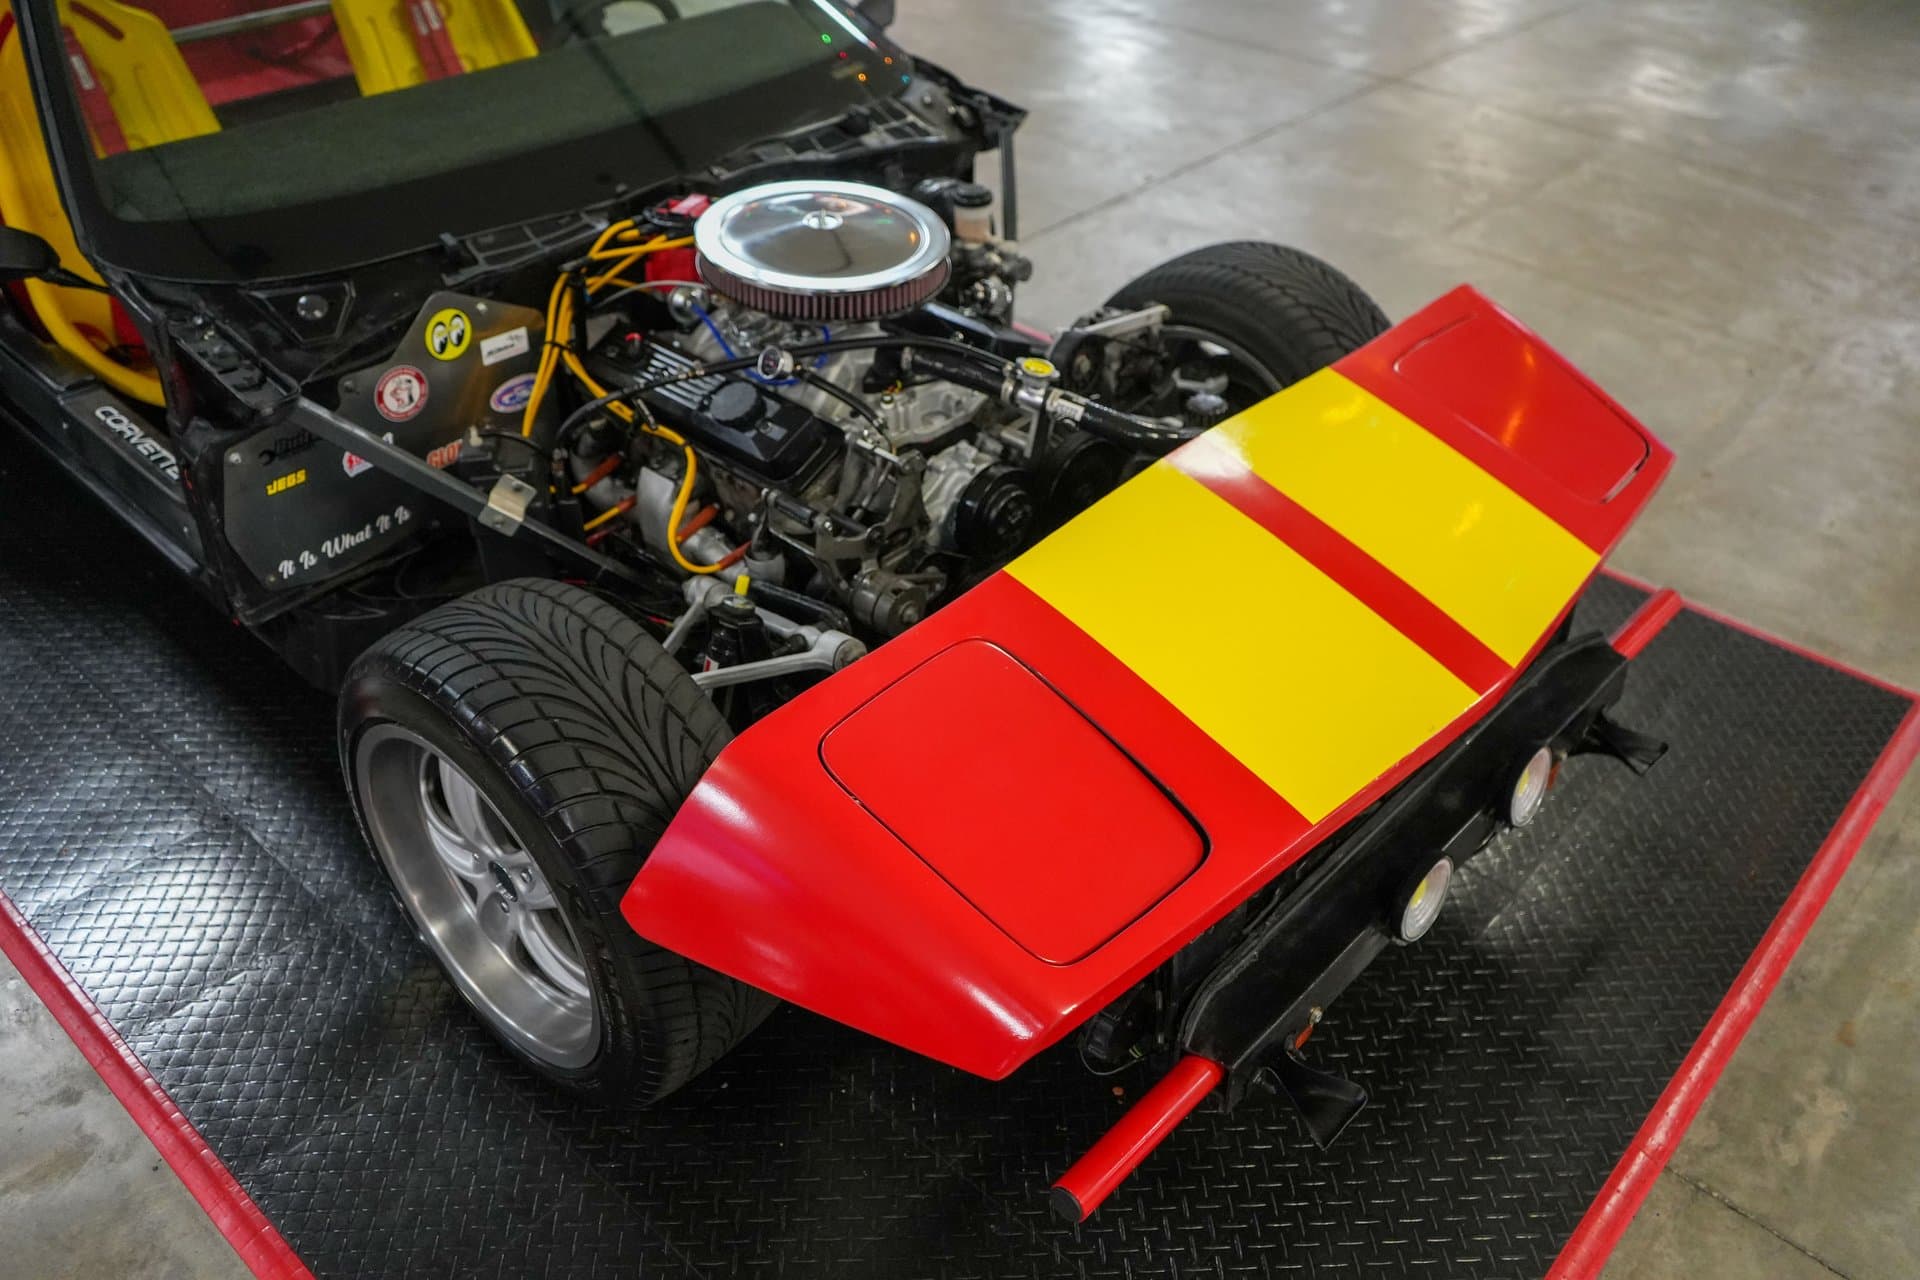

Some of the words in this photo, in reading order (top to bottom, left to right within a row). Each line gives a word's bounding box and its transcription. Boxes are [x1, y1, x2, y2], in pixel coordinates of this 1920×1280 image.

[278, 559, 296, 579] It
[299, 550, 318, 570] Is
[321, 523, 373, 558] What
[375, 514, 392, 533] It
[394, 505, 411, 525] Is
